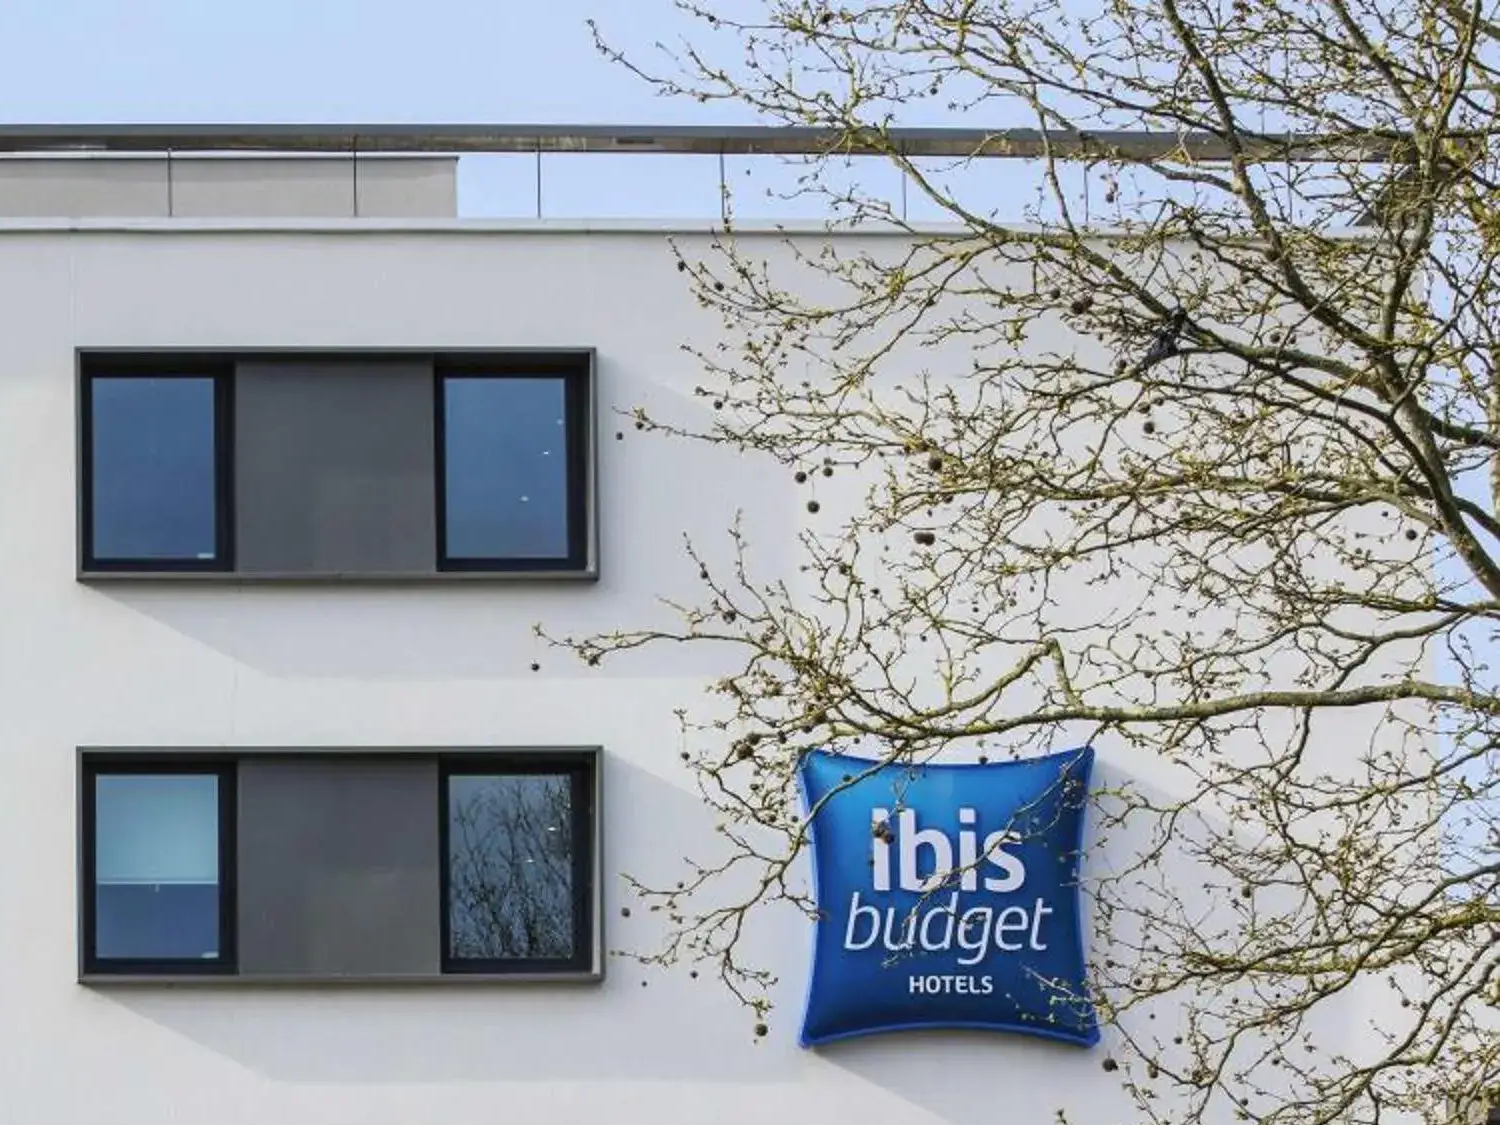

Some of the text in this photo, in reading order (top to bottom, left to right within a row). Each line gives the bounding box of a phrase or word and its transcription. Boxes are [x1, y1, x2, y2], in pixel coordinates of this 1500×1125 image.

[871, 807, 1026, 893] ibis
[843, 891, 1053, 966] budget
[909, 975, 994, 995] HOTELS
